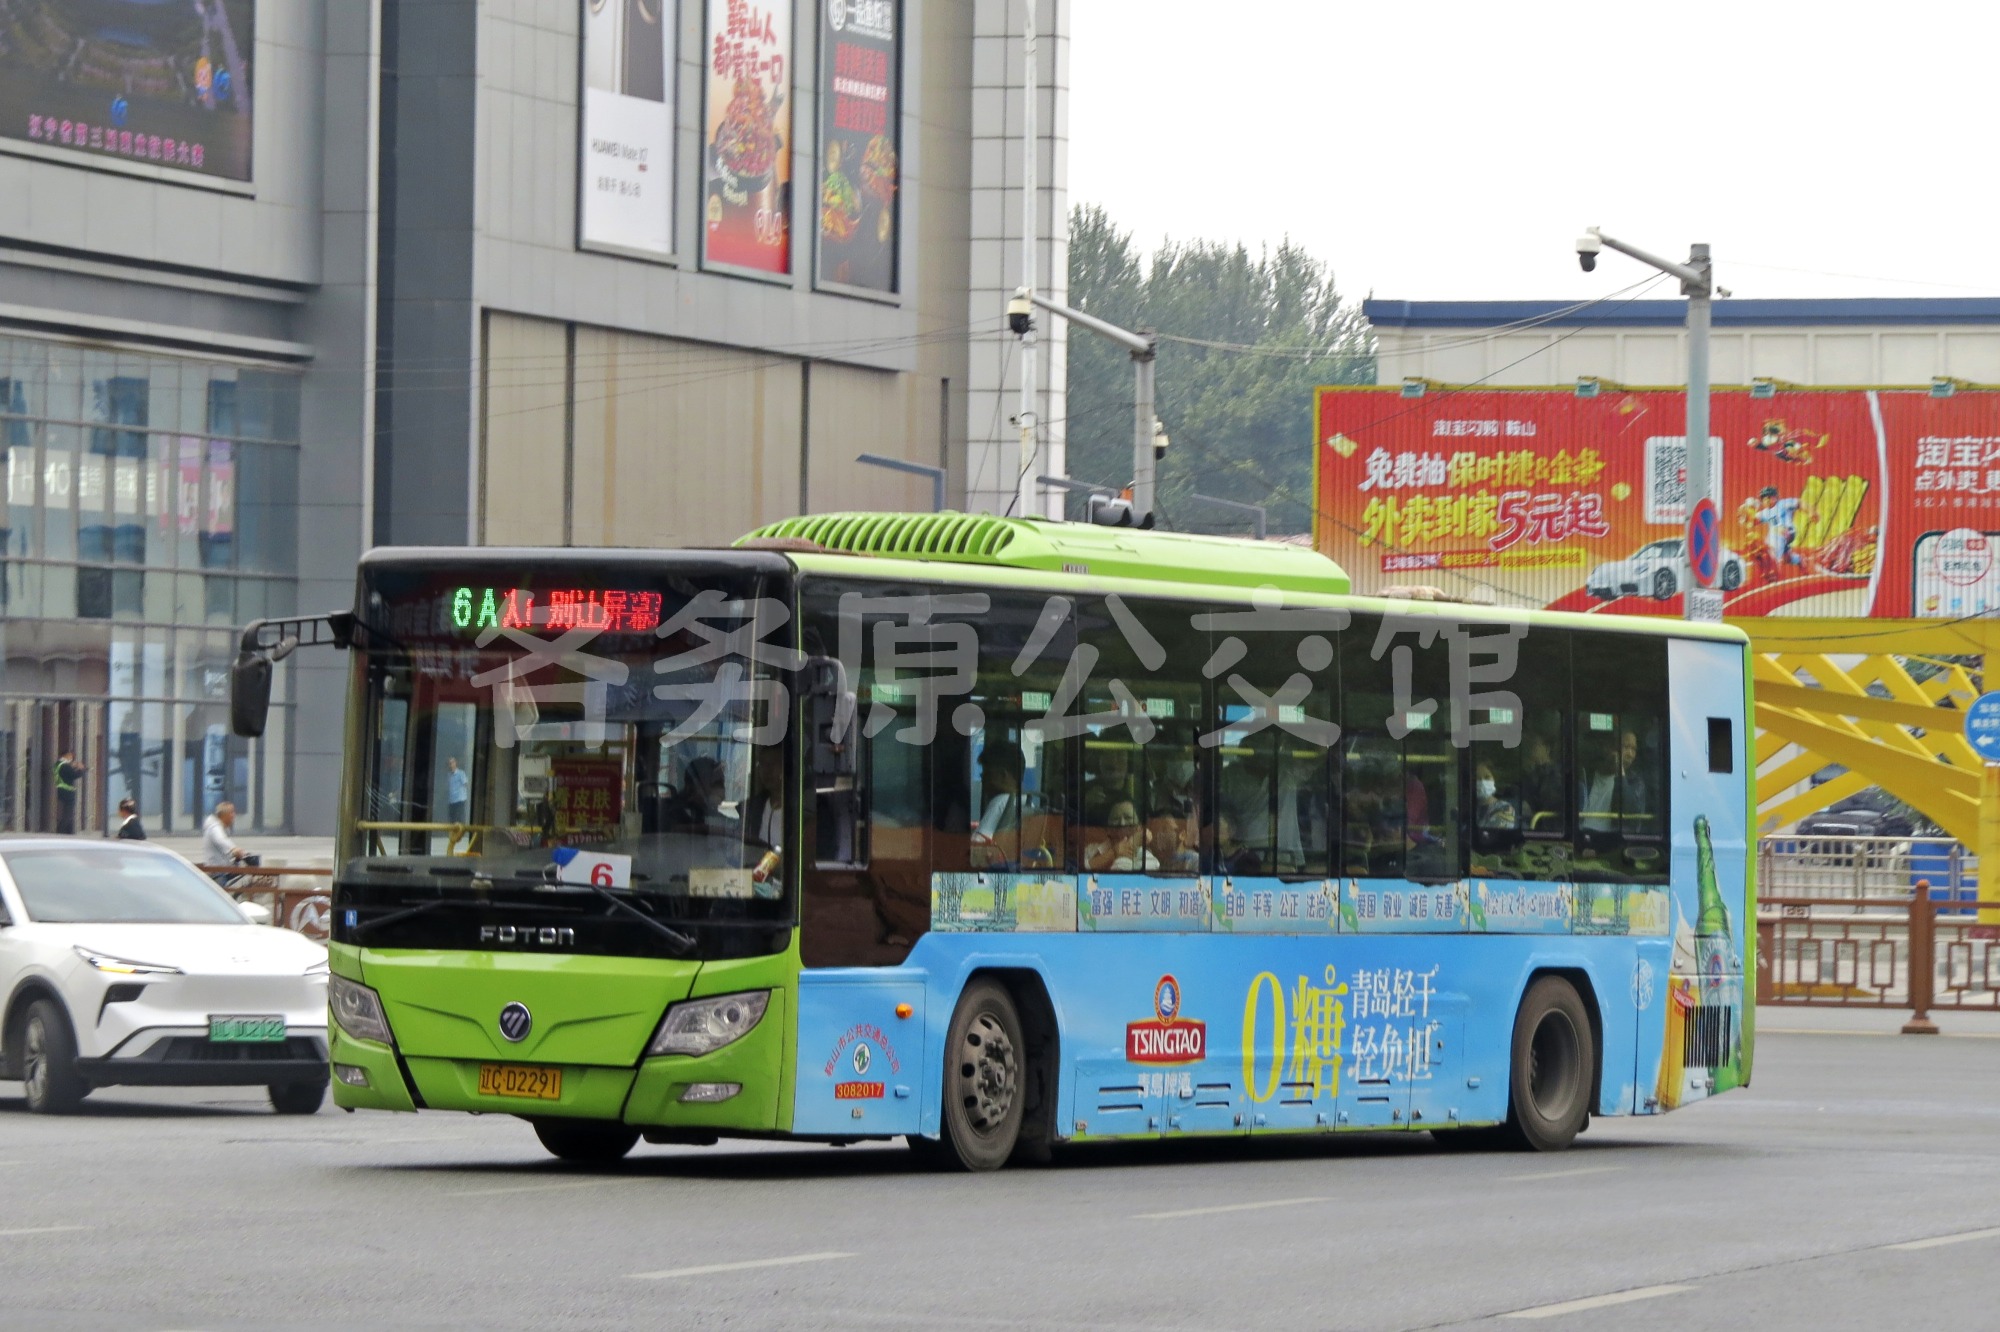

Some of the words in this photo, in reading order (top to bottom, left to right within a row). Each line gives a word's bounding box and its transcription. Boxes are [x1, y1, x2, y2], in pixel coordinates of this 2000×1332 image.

[1433, 419, 1499, 437] 淘宝闪购
[1506, 419, 1537, 436] 鞍山
[1358, 447, 1605, 492] 免费抽保时捷&金条
[1358, 488, 1610, 551] 外卖到家5元起
[453, 587, 498, 628] 6A
[591, 862, 614, 888] 6
[1091, 889, 1113, 917] 富强
[1121, 889, 1142, 917] 民主
[1149, 889, 1171, 917] 文明
[1178, 889, 1201, 918] 和谐
[1224, 891, 1246, 918] 自由
[1252, 892, 1273, 918] 平等
[1279, 892, 1300, 918] 公正
[1305, 893, 1327, 920] 法治
[1355, 892, 1377, 920] 爱国
[1383, 893, 1403, 920] 敬业
[1408, 893, 1429, 920] 诚信
[1434, 893, 1455, 920] 友善
[480, 925, 575, 946] FOTON
[1132, 1028, 1201, 1055] TSINGTAO
[1347, 1023, 1434, 1083] 轻负担
[837, 1083, 883, 1098] 3082017
